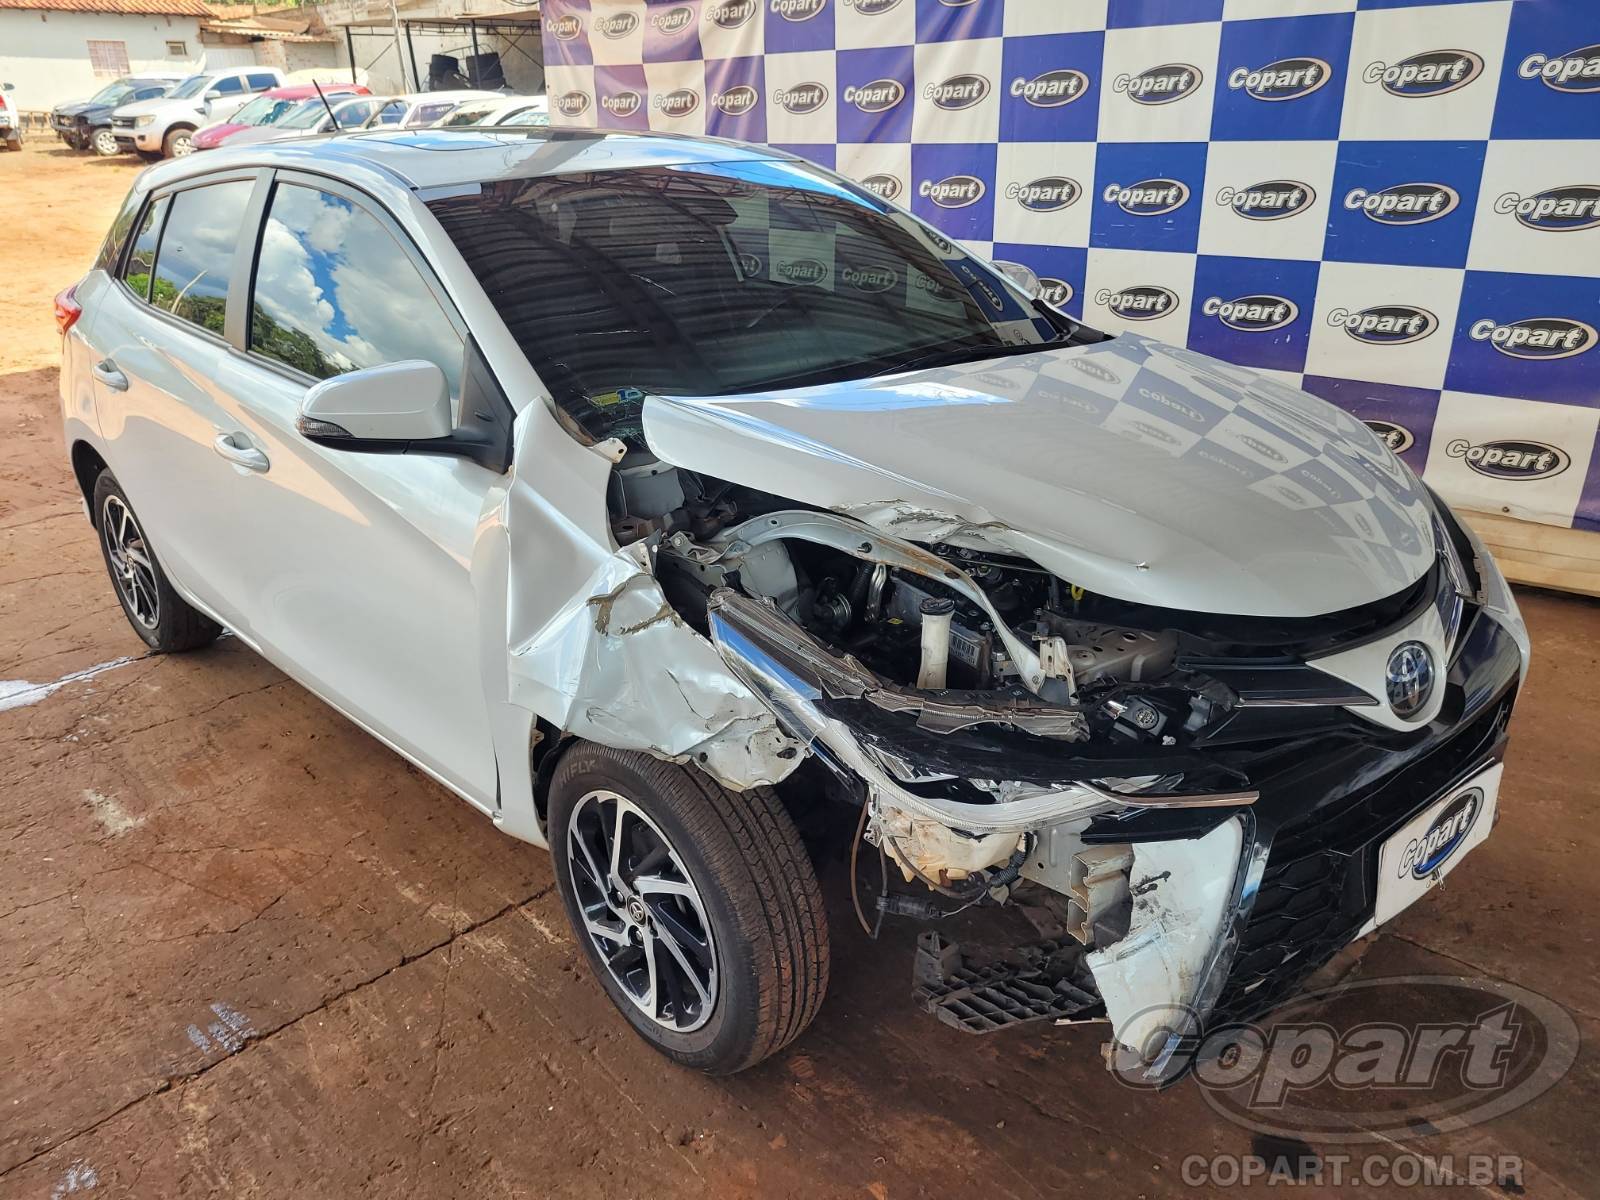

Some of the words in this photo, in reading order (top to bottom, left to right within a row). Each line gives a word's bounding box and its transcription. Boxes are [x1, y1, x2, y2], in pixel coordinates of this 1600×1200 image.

[595, 15, 633, 34] Copart
[651, 11, 689, 30] Copart
[705, 2, 750, 23] Copart
[546, 19, 578, 34] Copart
[1228, 64, 1320, 93] Copart
[1362, 56, 1469, 91] Copart
[1518, 53, 1600, 84] Copa
[923, 79, 980, 105] Copart
[1010, 73, 1079, 100] Copart
[1112, 68, 1191, 95] Copart
[601, 93, 636, 109] Copart
[654, 93, 693, 110] Copart
[711, 91, 751, 107] Copart
[773, 87, 820, 107] Copart
[844, 85, 897, 107] Copart
[919, 180, 977, 200] Copart
[1005, 181, 1074, 205] Copart
[1103, 183, 1179, 207] Copart
[1215, 186, 1305, 213] Copart
[1344, 188, 1451, 217] Copart
[1095, 289, 1169, 312] Copart
[1202, 296, 1287, 322] Copart
[1326, 308, 1425, 335] Copart
[1469, 319, 1585, 350] Copart
[1446, 439, 1554, 471] Copart
[1398, 794, 1475, 879] Copart
